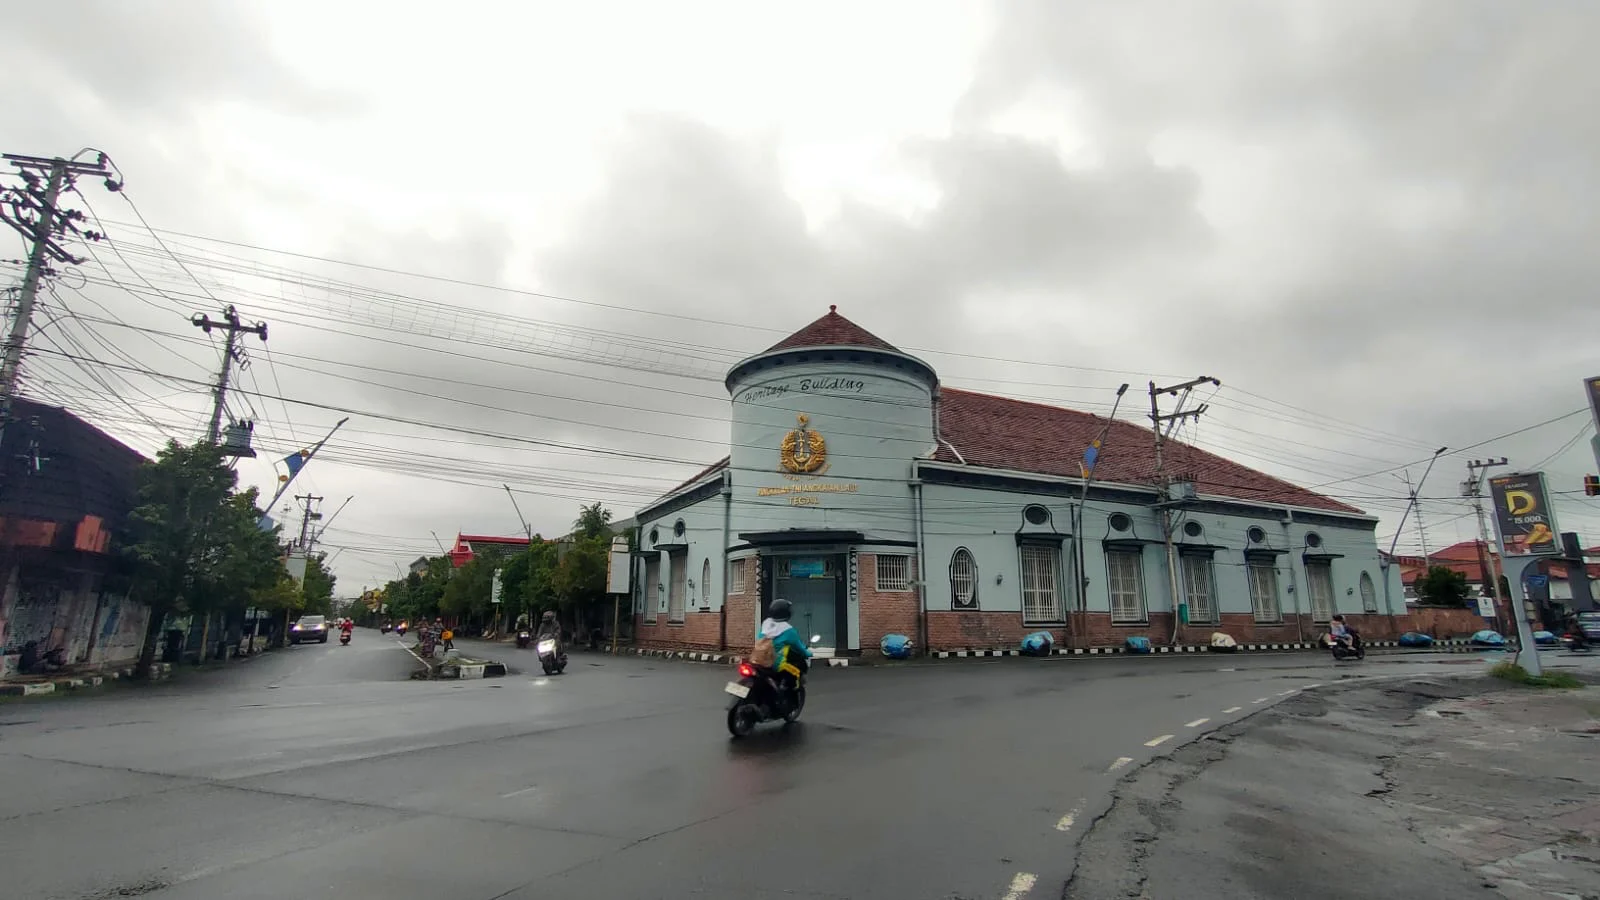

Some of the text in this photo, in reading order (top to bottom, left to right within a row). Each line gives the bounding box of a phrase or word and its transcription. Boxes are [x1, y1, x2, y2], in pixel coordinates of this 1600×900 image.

[744, 378, 865, 402] Heritage Building
[788, 496, 820, 505] TEGAL
